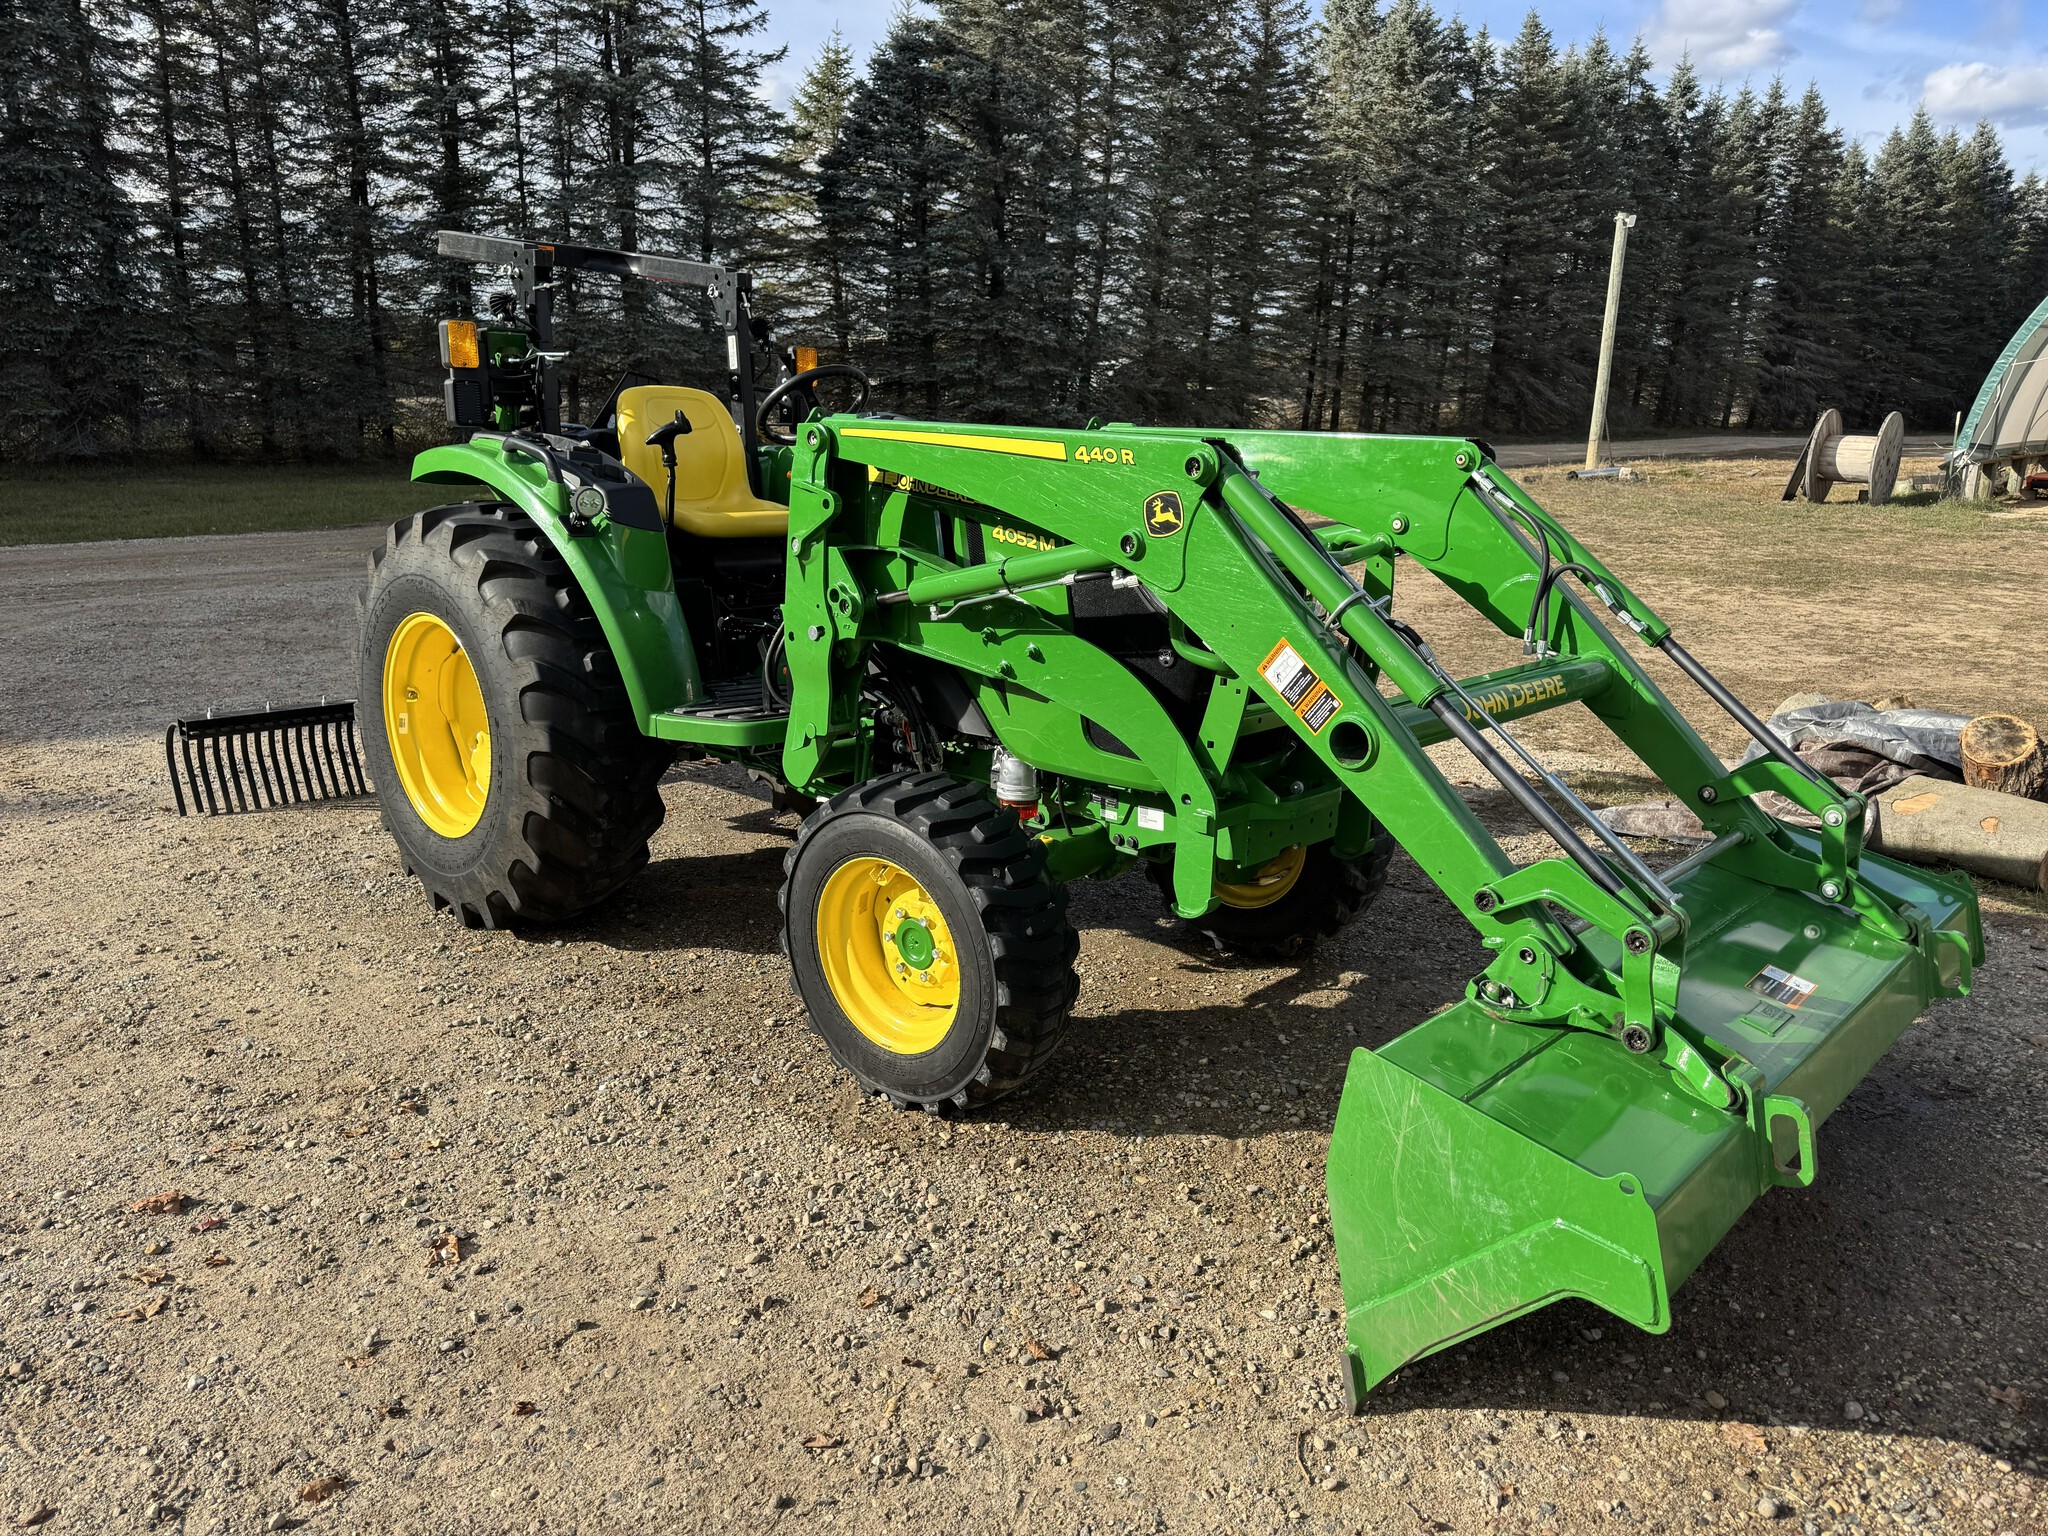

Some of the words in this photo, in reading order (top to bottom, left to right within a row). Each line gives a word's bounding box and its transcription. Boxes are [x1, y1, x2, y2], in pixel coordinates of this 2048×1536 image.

[1074, 445, 1118, 464] 440
[1120, 448, 1137, 466] R
[891, 474, 925, 493] JOHN
[991, 525, 1037, 550] 4052
[1039, 535, 1056, 552] M
[1266, 643, 1285, 665] WARNING
[1304, 686, 1324, 708] WARNING
[1506, 675, 1566, 708] DEERE
[975, 935, 991, 1034] XD2010
